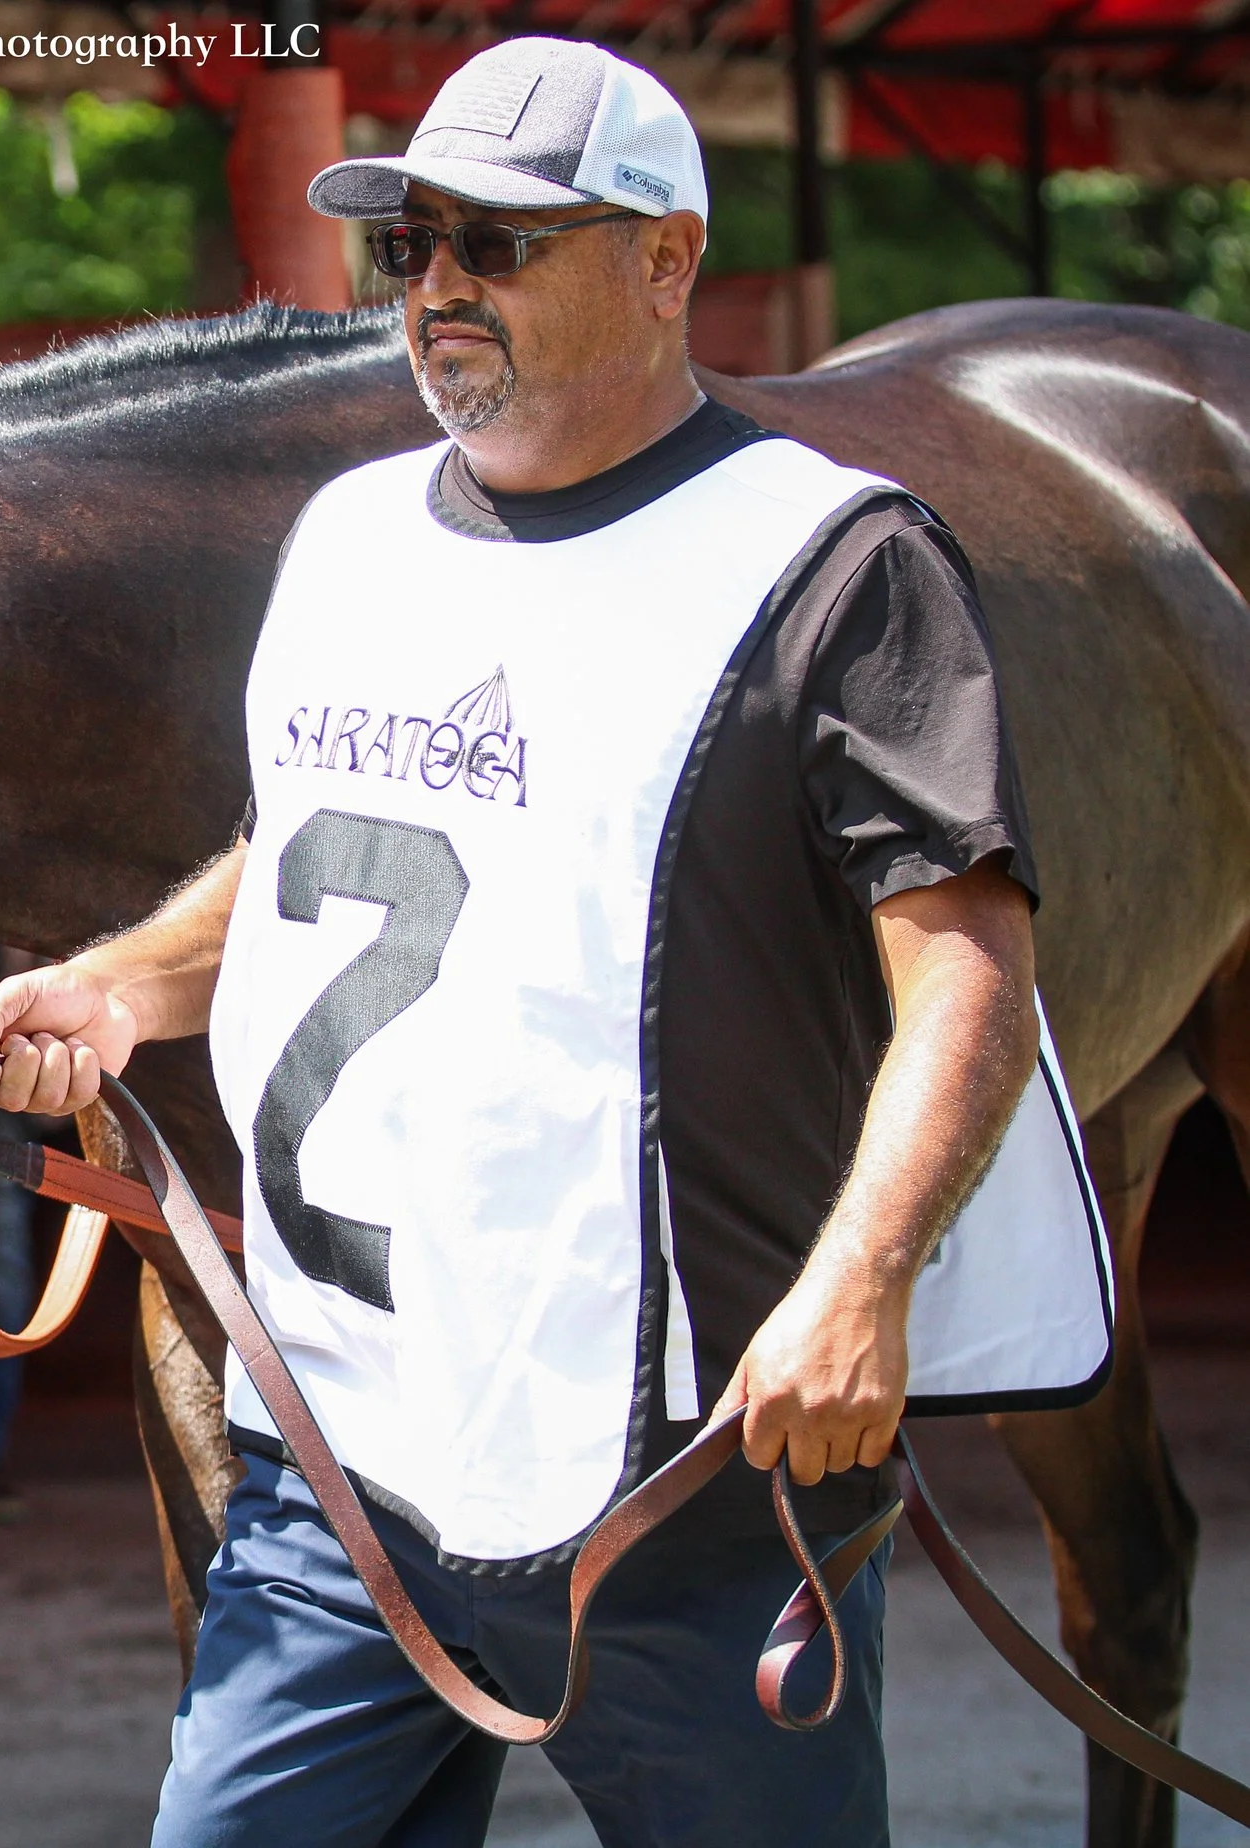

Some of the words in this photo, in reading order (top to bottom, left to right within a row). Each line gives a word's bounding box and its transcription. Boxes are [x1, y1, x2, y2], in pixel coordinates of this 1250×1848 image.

[633, 173, 670, 198] Columbia
[275, 706, 528, 808] SARATOGA
[252, 808, 470, 1314] 2
